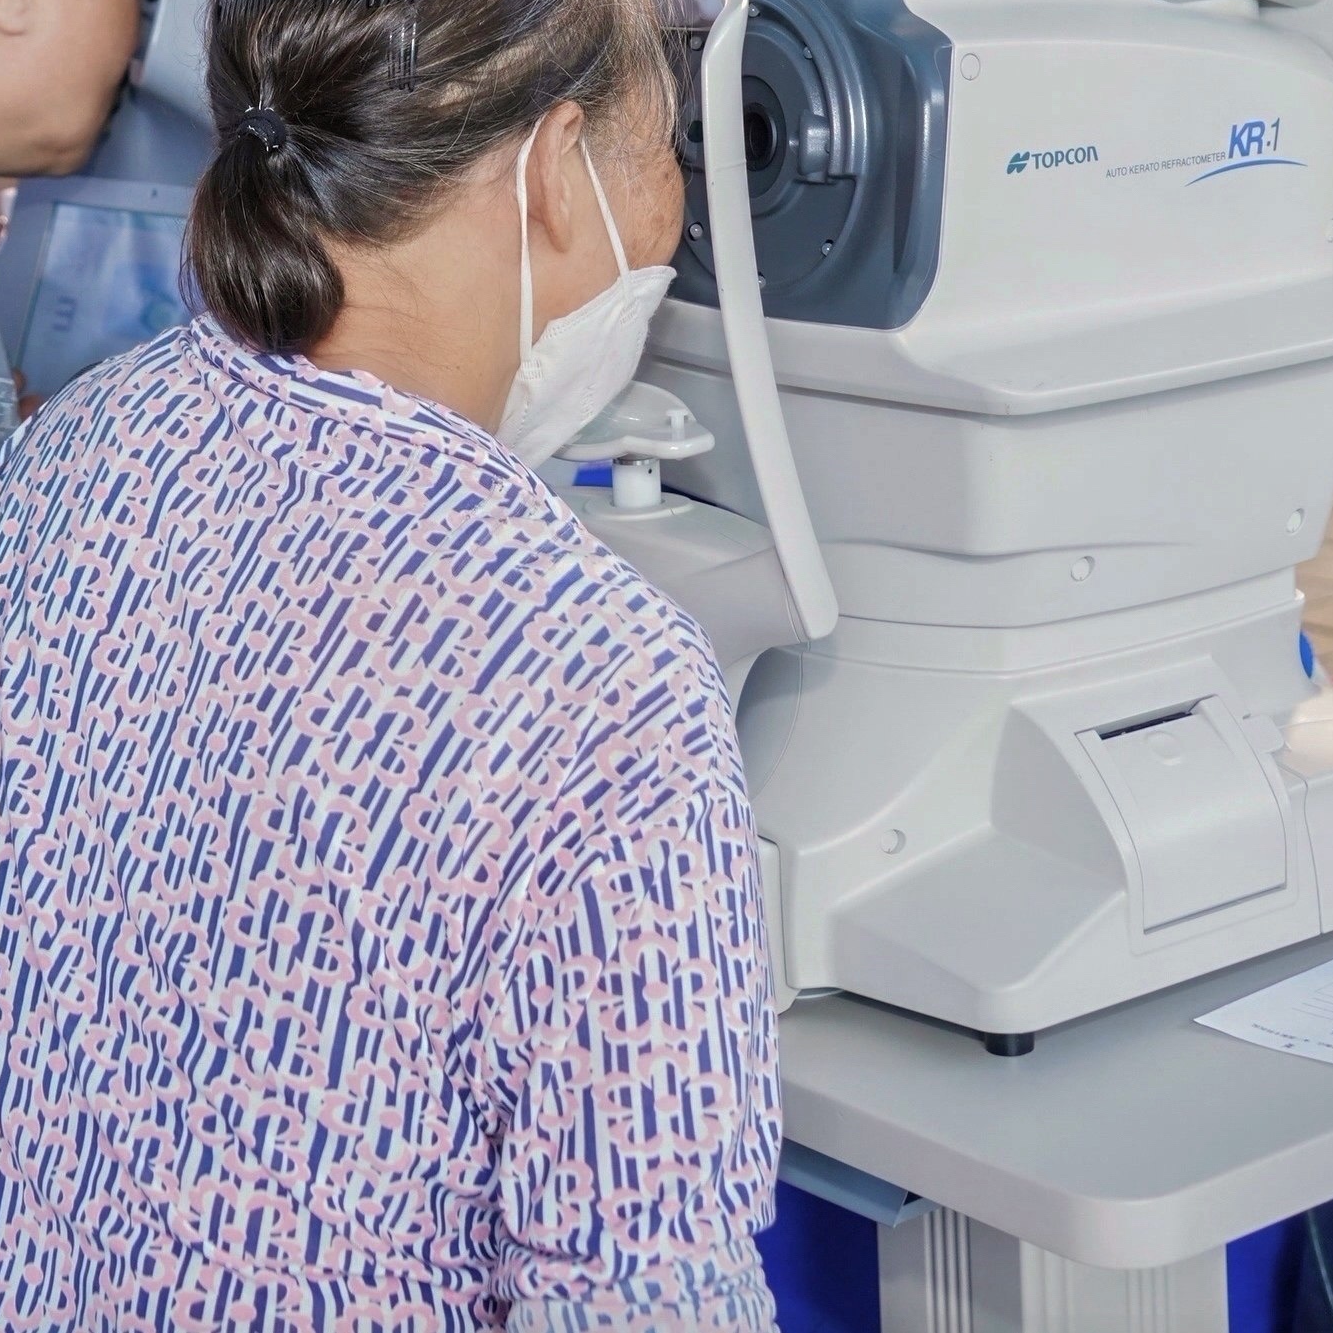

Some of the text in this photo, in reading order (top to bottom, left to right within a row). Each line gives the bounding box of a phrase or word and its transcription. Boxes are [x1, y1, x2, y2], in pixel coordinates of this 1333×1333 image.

[1031, 146, 1098, 169] TOPCON
[1105, 167, 1127, 178] AUTO
[1128, 161, 1159, 175] KERATO
[1160, 151, 1226, 170] REFRACTOMETER
